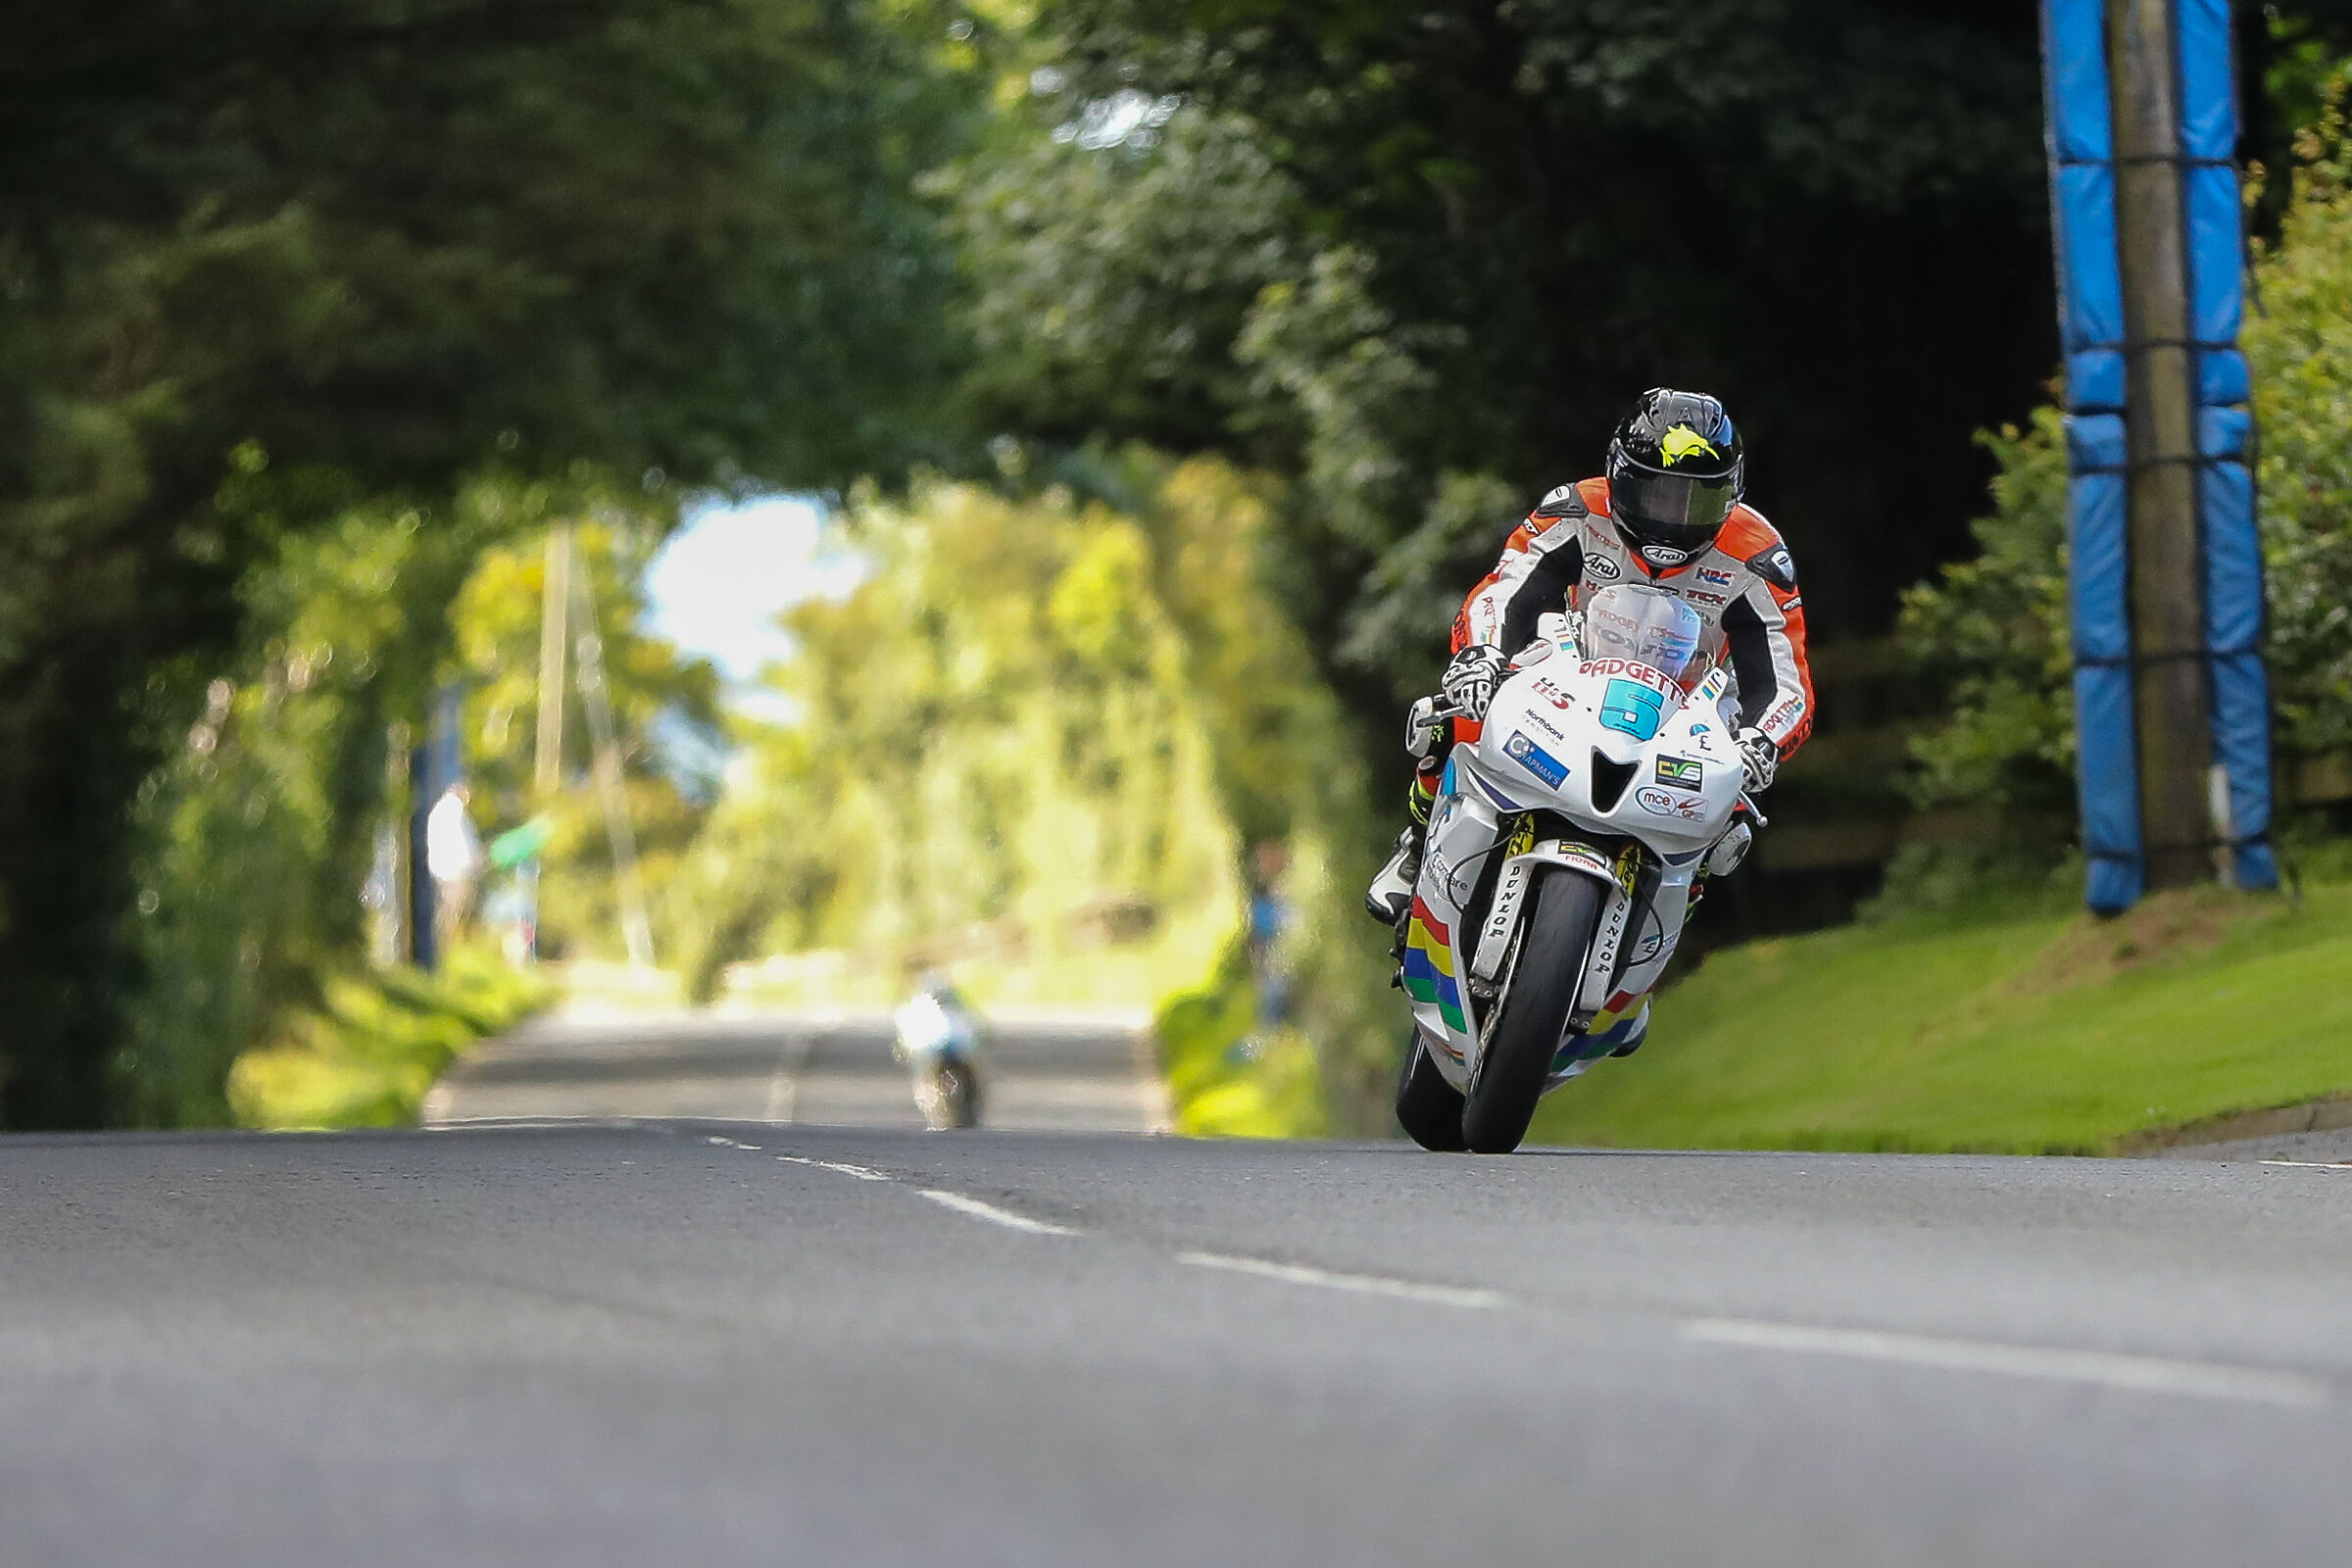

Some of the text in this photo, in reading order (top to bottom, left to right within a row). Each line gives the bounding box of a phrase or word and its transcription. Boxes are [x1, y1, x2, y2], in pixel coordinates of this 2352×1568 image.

[1585, 556, 1616, 576] Arai
[1695, 566, 1733, 586] HRC
[1687, 589, 1726, 605] TCX
[1579, 660, 1690, 710] PADGETTS
[1526, 709, 1565, 741] Northbank
[1510, 737, 1561, 785] CHAPMAN'S
[1658, 760, 1701, 781] CVS
[1644, 793, 1670, 806] mce
[1488, 866, 1521, 938] DUNLOP
[1595, 902, 1625, 974] DUNLOP
